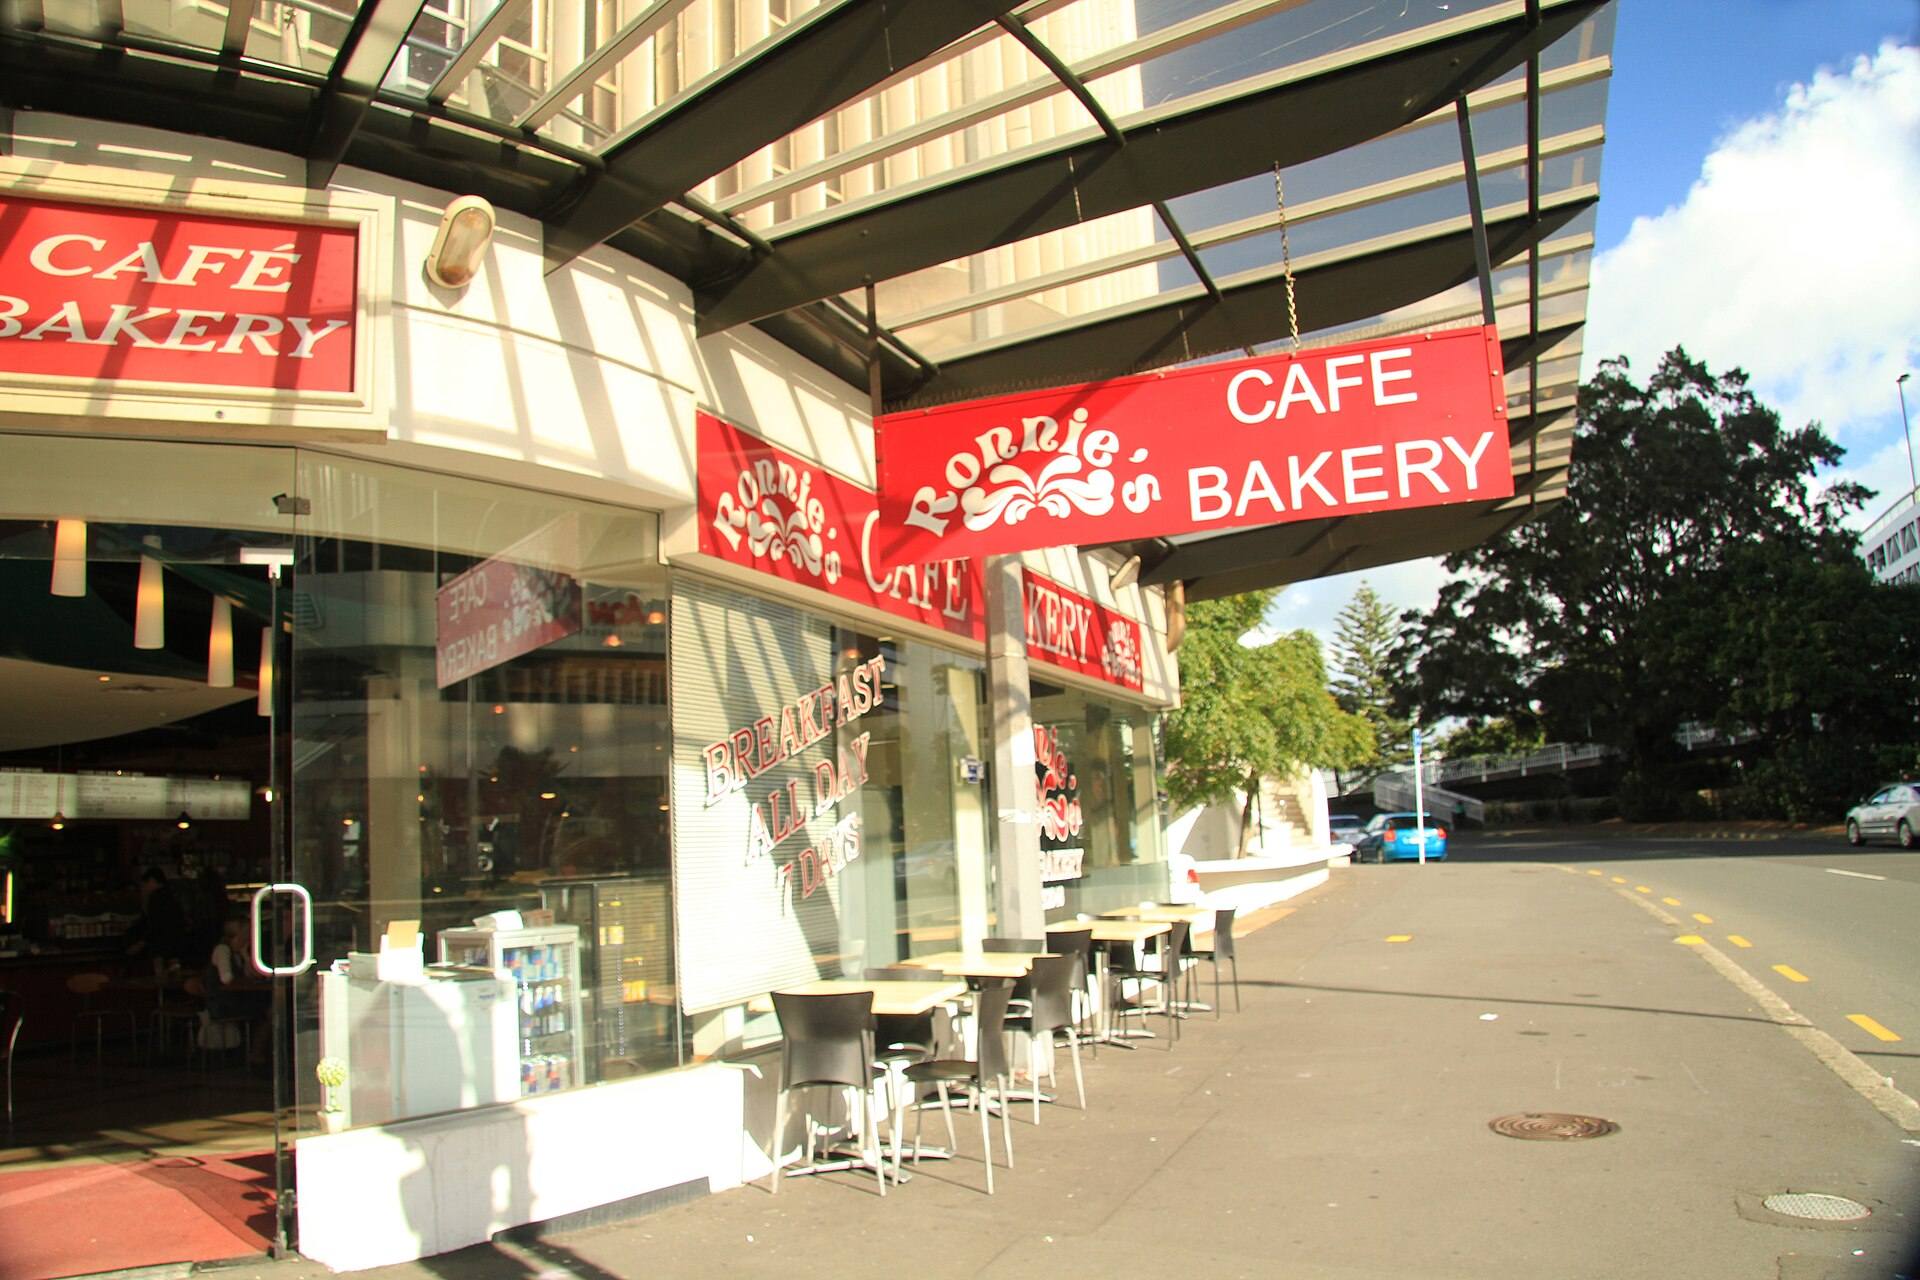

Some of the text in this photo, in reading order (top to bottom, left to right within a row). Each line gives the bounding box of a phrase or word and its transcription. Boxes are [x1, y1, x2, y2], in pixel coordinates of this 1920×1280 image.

[30, 234, 301, 293] CAFÉ
[0, 295, 348, 359] BAKERY
[1226, 347, 1418, 424] CAFE
[903, 407, 1162, 538] Ronnie's
[1187, 431, 1496, 522] BAKERY
[712, 459, 842, 585] Ronnie's
[1026, 582, 1092, 665] KERY
[702, 654, 887, 806] BREAKFAST
[750, 731, 871, 861] ALL DAY
[798, 811, 863, 899] DAYS
